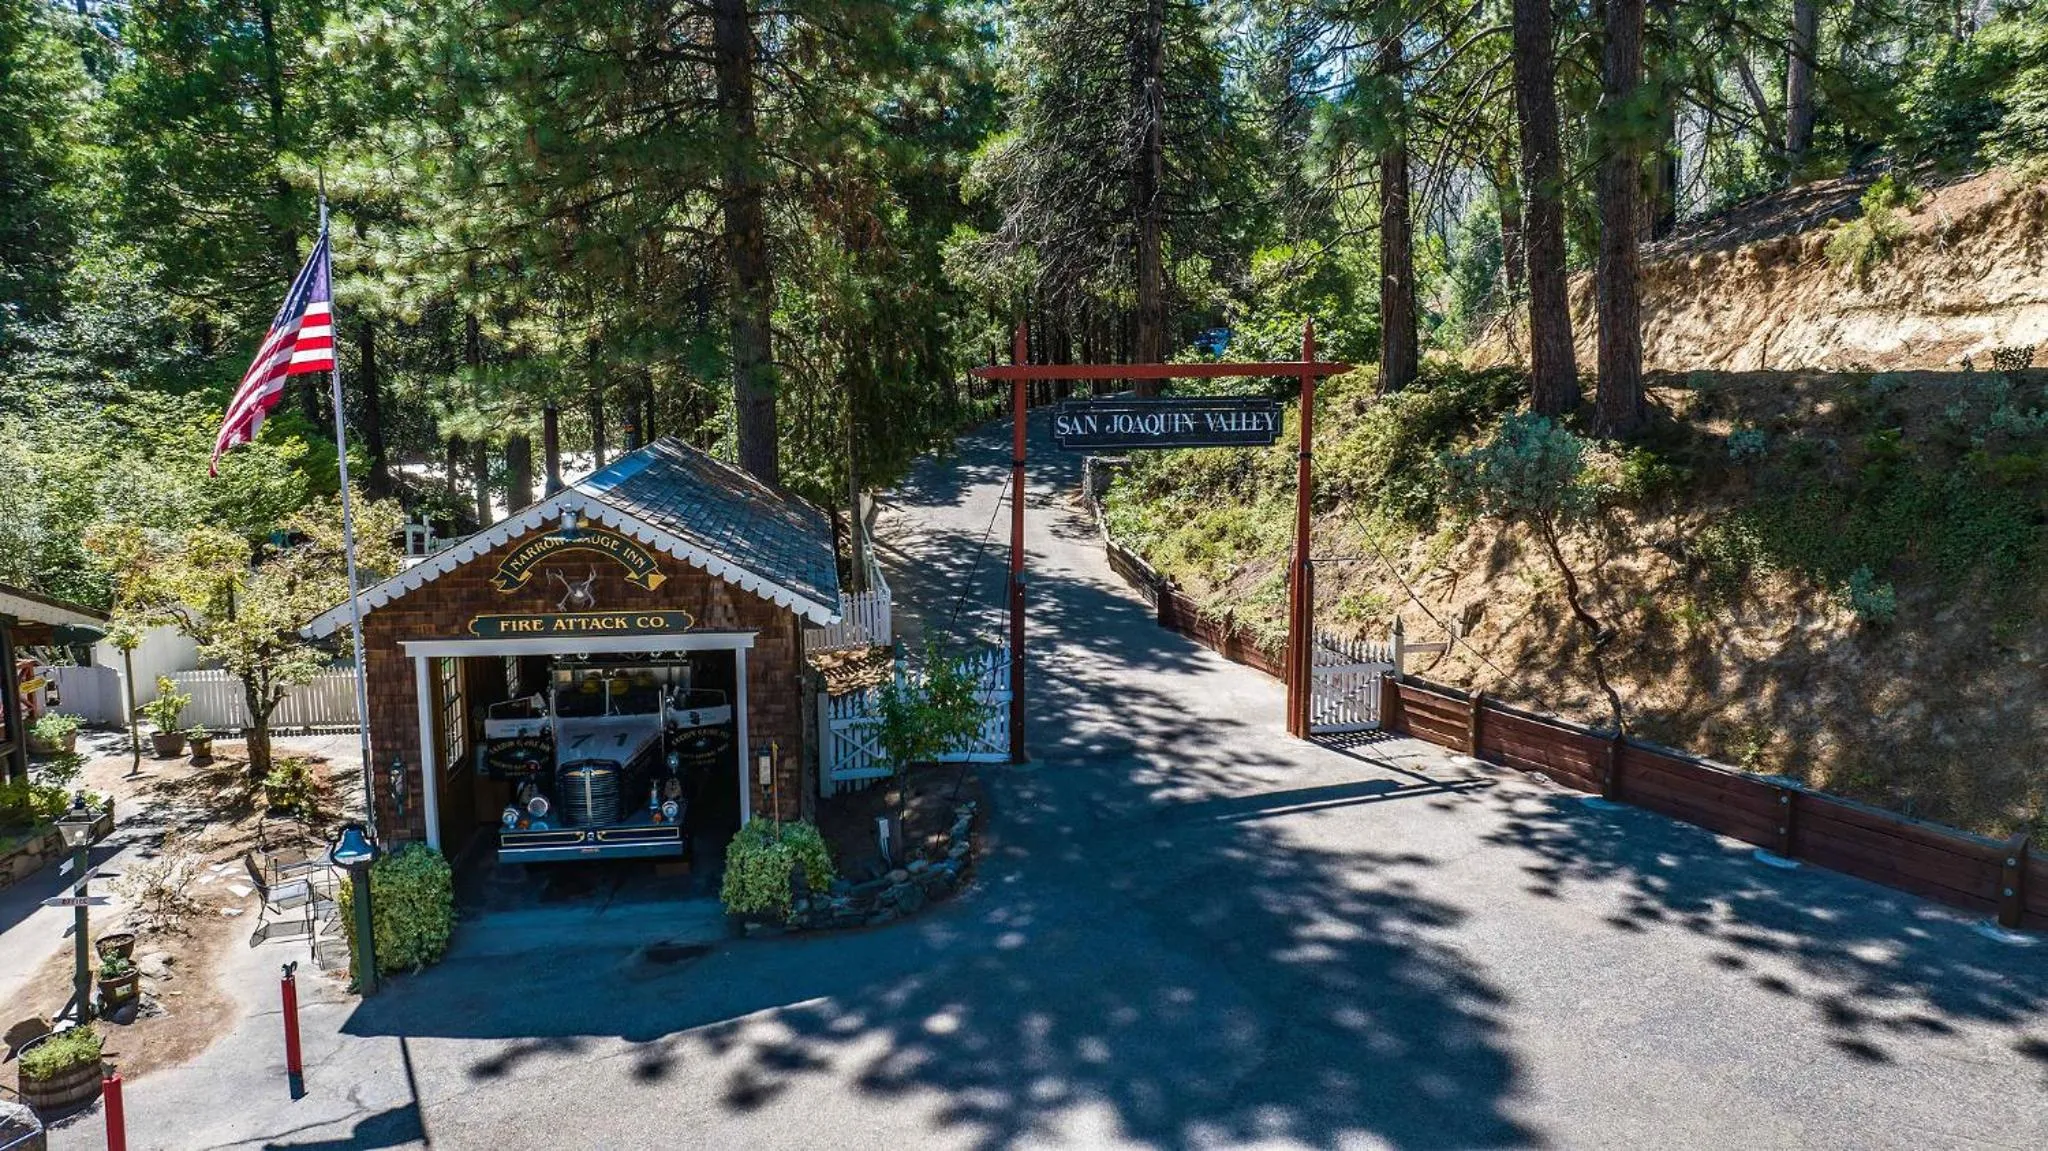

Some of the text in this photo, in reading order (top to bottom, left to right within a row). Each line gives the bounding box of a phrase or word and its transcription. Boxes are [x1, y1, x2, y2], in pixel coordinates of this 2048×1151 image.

[1057, 411, 1278, 435] SAN JOAQUIN VALLEY
[622, 547, 648, 569] INN
[500, 616, 669, 632] FIRE ATTACK CO.
